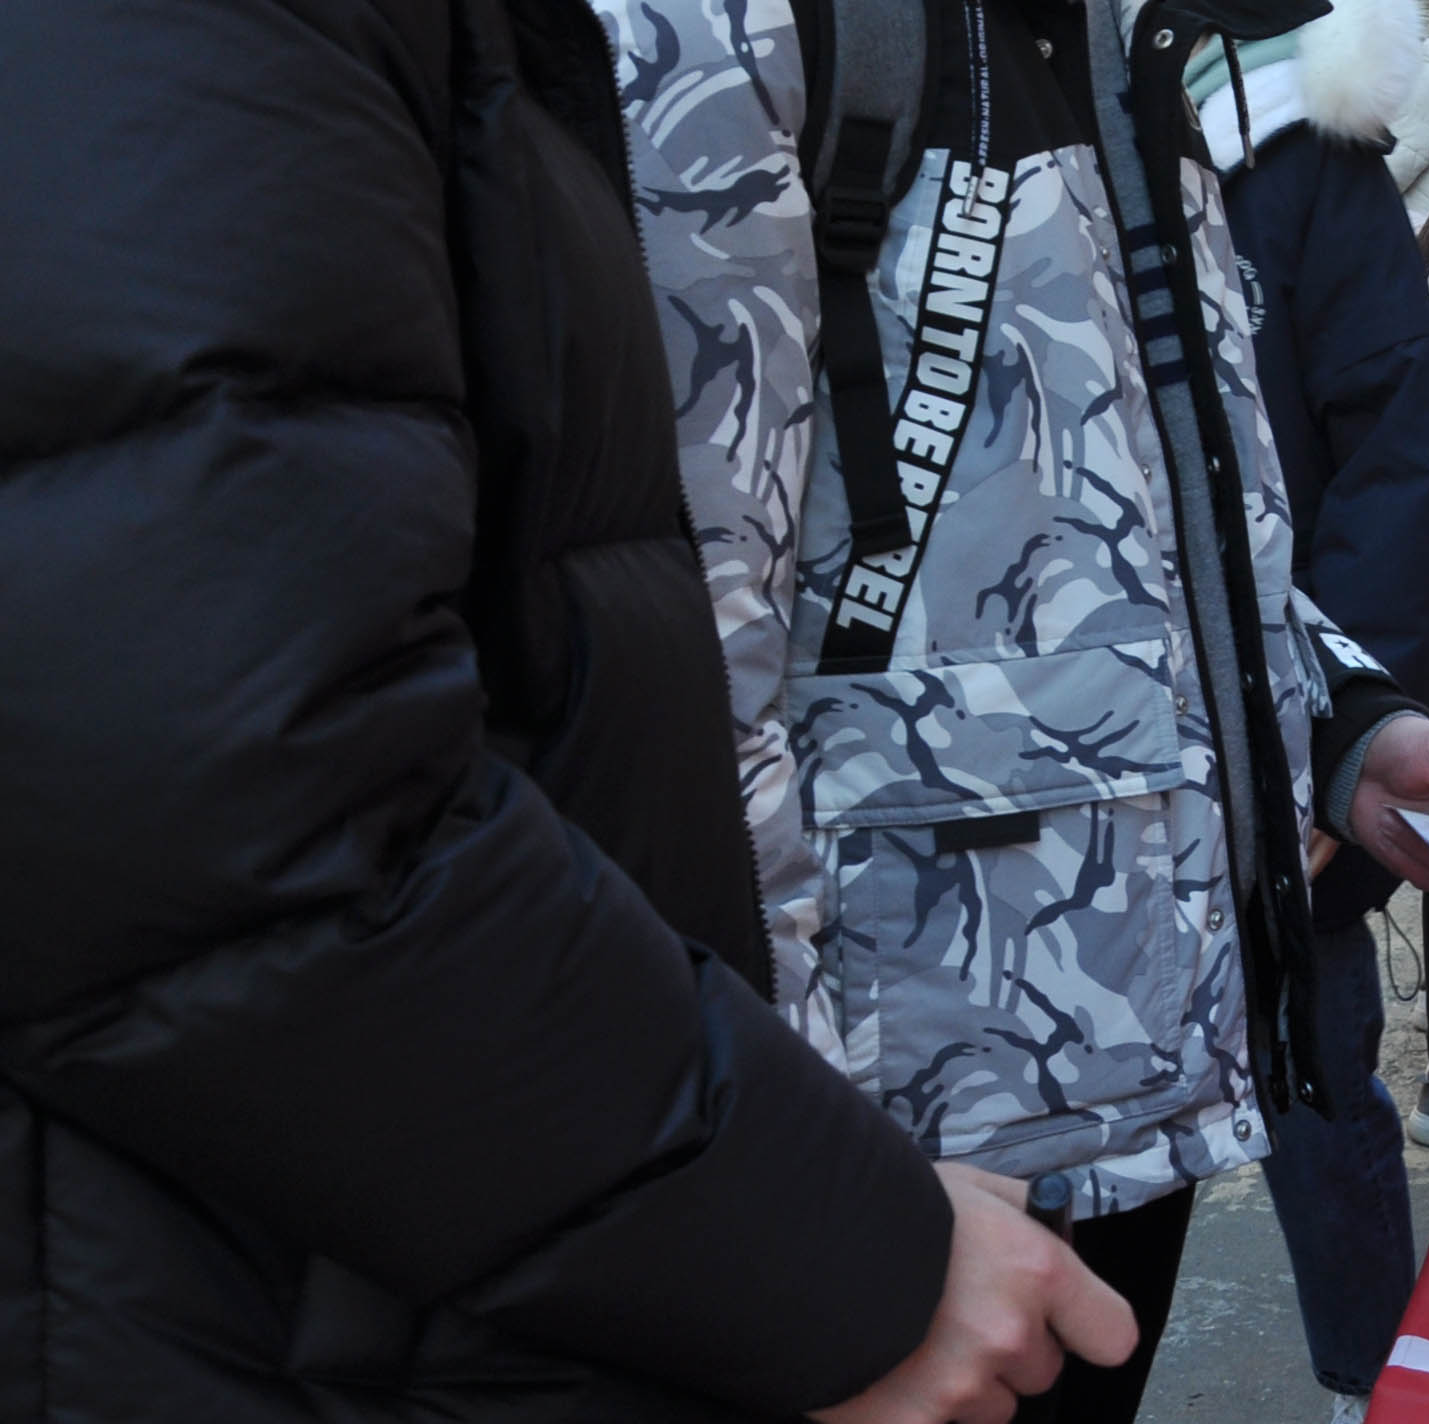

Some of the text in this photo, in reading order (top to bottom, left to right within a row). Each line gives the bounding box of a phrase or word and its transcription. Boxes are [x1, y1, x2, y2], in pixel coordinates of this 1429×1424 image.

[834, 160, 1010, 634] BORN TO BE RBEL
